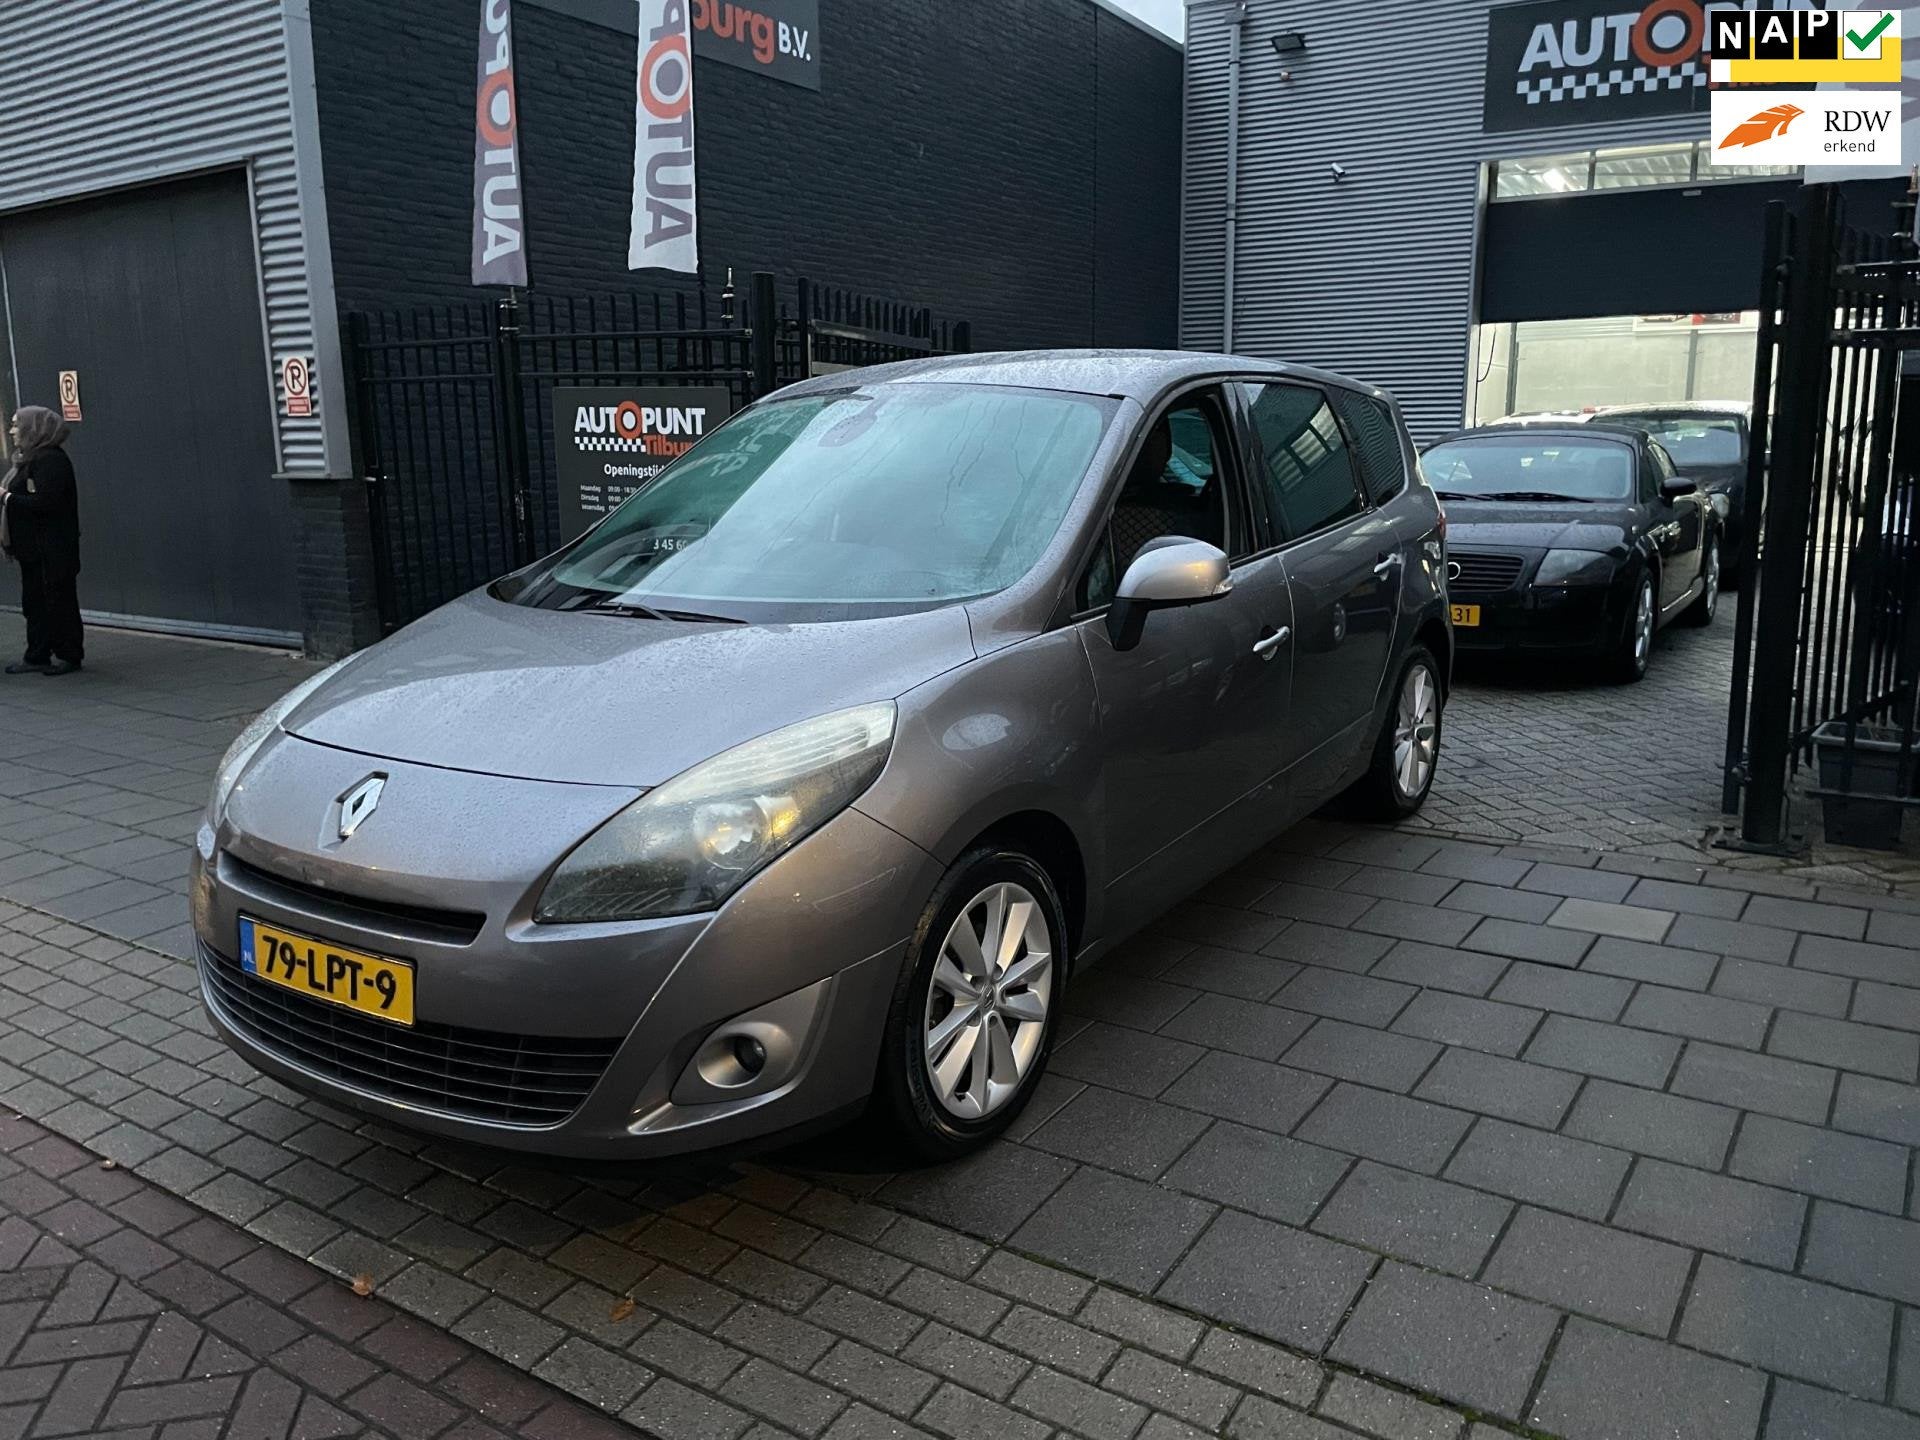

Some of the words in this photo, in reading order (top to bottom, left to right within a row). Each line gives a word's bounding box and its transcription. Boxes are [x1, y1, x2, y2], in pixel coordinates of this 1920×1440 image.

[778, 20, 811, 62] B.V.
[575, 401, 705, 438] AUTOPUNT
[661, 539, 674, 550] 45
[262, 935, 397, 1010] 79-LPT-9
